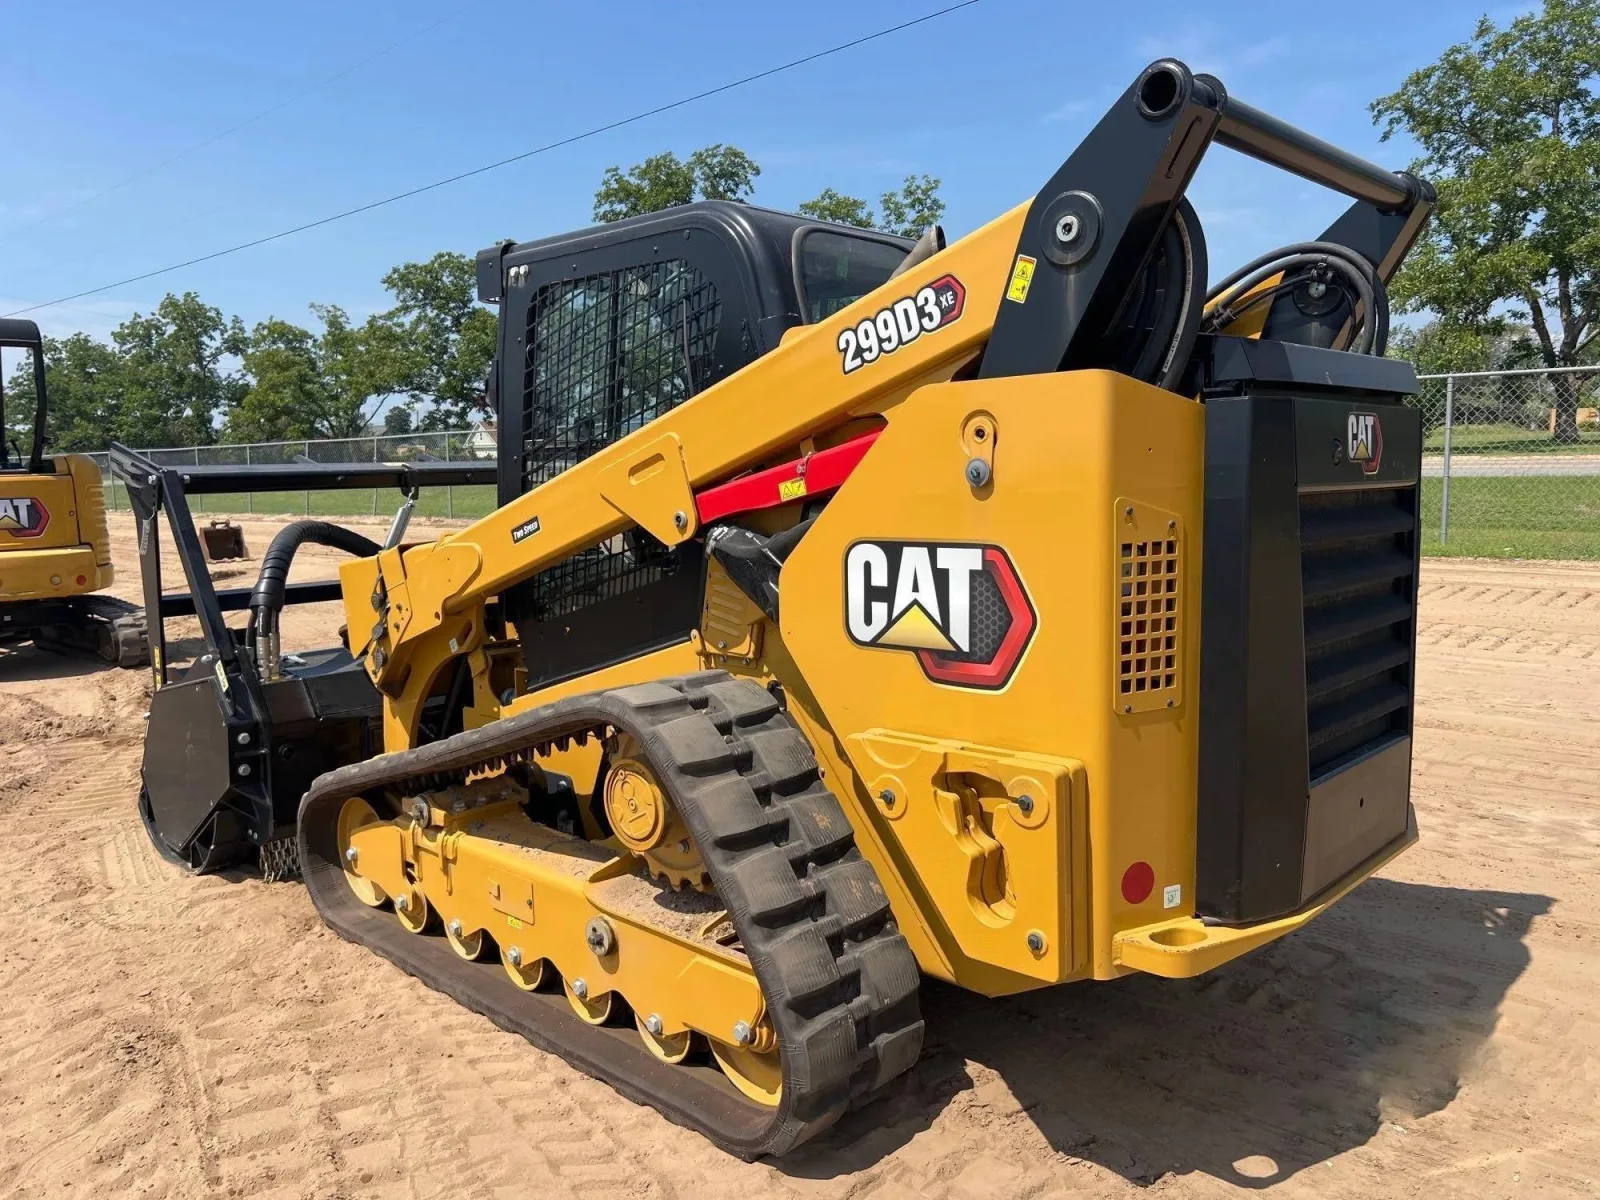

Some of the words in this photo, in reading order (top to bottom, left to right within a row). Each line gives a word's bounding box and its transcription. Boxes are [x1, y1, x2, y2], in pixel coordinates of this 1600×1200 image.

[838, 287, 941, 373] 299D3
[939, 290, 955, 309] XE
[1347, 414, 1374, 459] CAT
[0, 498, 31, 528] AT
[847, 543, 983, 653] CAT
